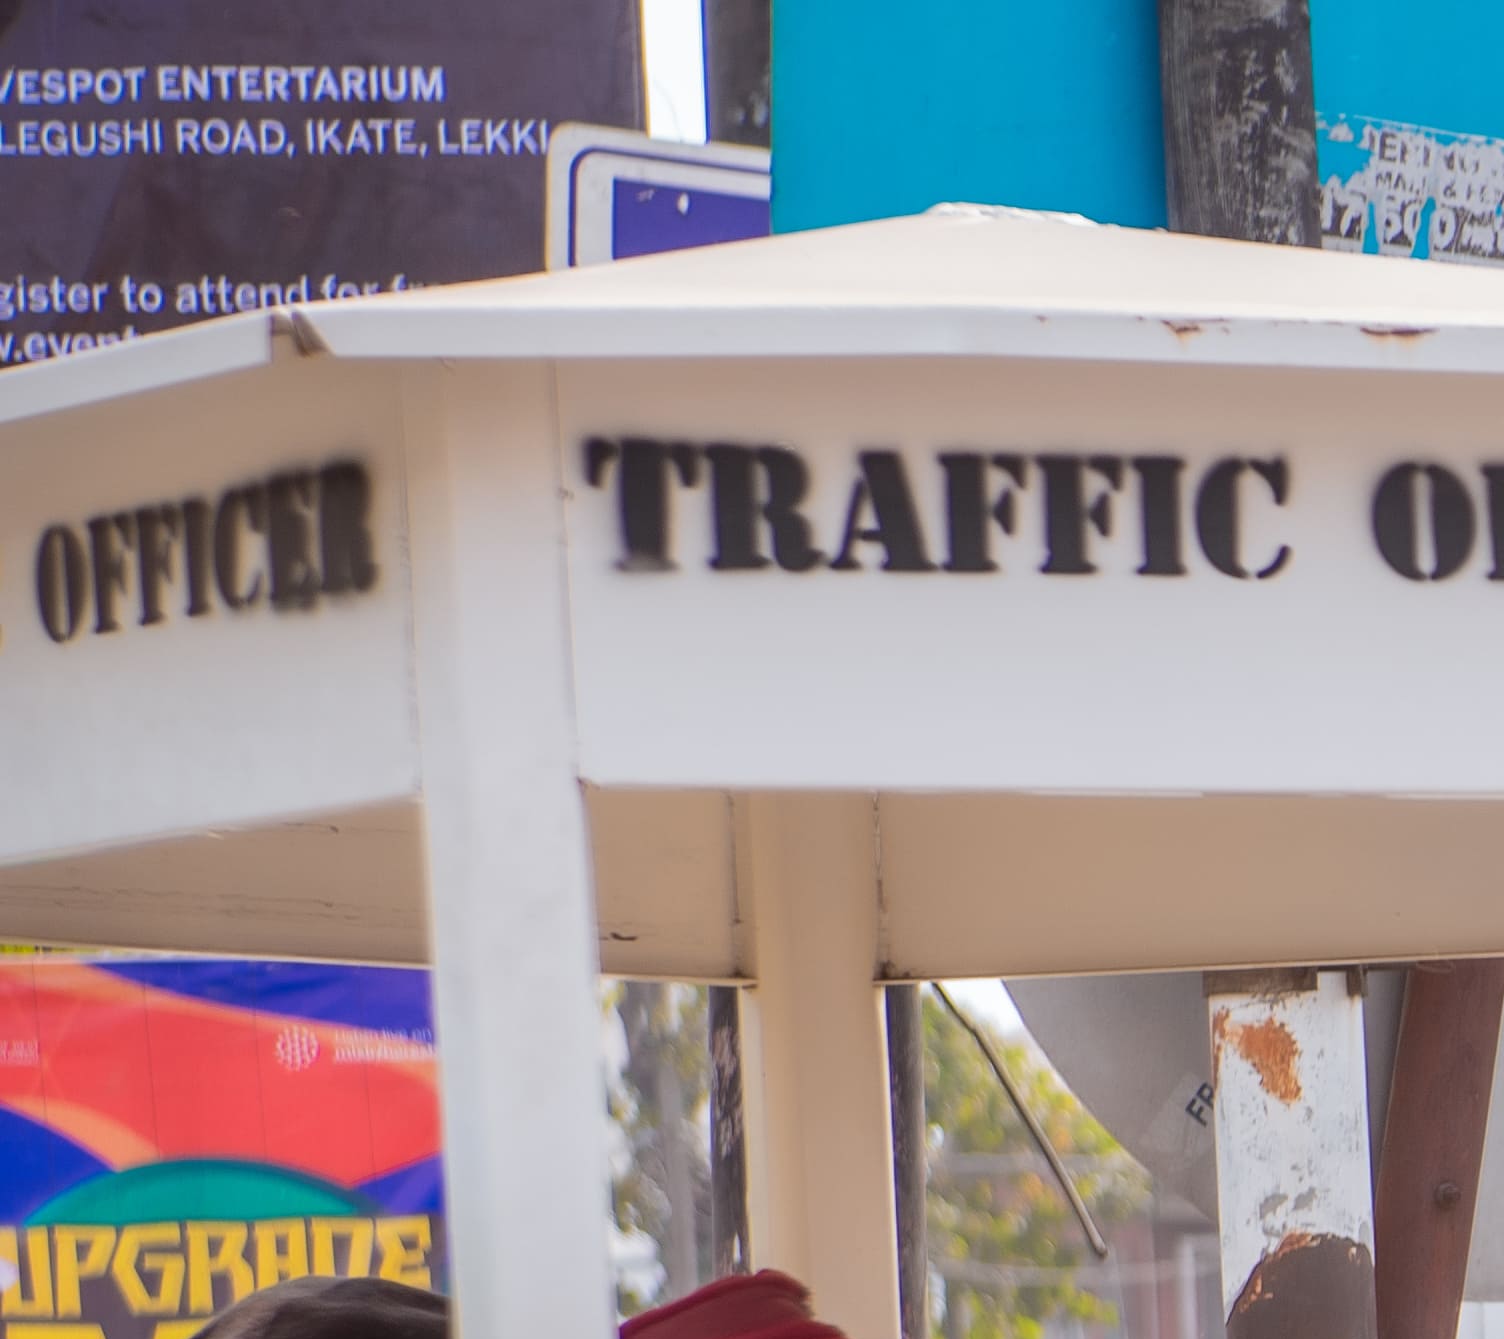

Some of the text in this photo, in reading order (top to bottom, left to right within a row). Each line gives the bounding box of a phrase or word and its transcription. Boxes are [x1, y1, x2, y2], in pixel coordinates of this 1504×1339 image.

[158, 65, 445, 103] ENTERTARIUM
[176, 117, 296, 159] ROAD,
[305, 117, 428, 159] IKATE,
[438, 117, 549, 156] LEKKI
[120, 274, 164, 314] to
[176, 273, 311, 314] attend
[582, 436, 1293, 579] TRAFFIC
[35, 458, 378, 644] OFFICER
[0, 1214, 433, 1319] UPGRADE
